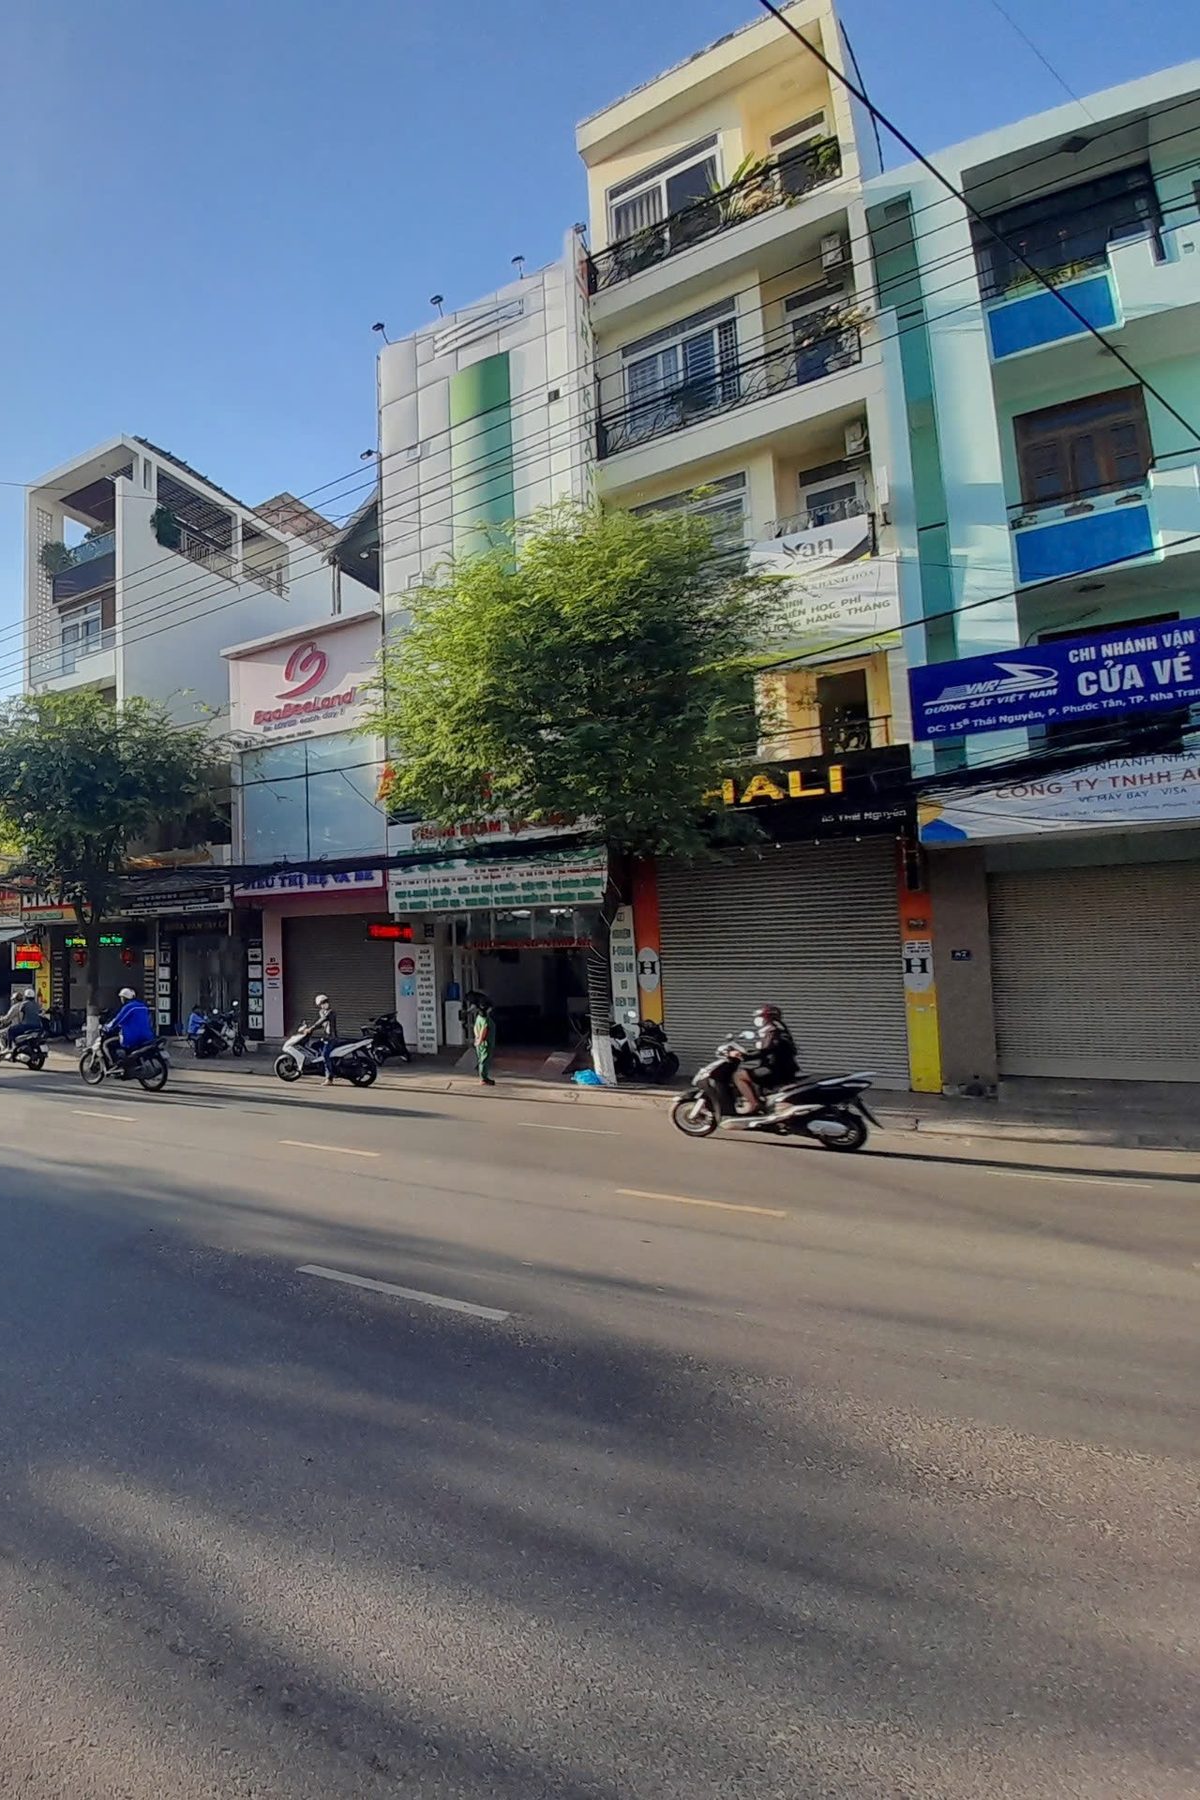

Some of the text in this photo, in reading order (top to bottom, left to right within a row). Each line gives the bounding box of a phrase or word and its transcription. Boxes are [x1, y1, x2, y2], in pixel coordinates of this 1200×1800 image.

[1068, 629, 1195, 663] CHI NHÁNH VẬN
[1077, 651, 1194, 696] CỬA VÉ
[1029, 688, 1059, 699] NAM
[972, 717, 997, 727] Thái
[1150, 692, 1174, 702] Nha
[1072, 778, 1099, 792] TY
[1108, 770, 1172, 788] TNHH
[1182, 768, 1200, 781] A
[639, 960, 657, 975] H
[903, 957, 929, 974] H
